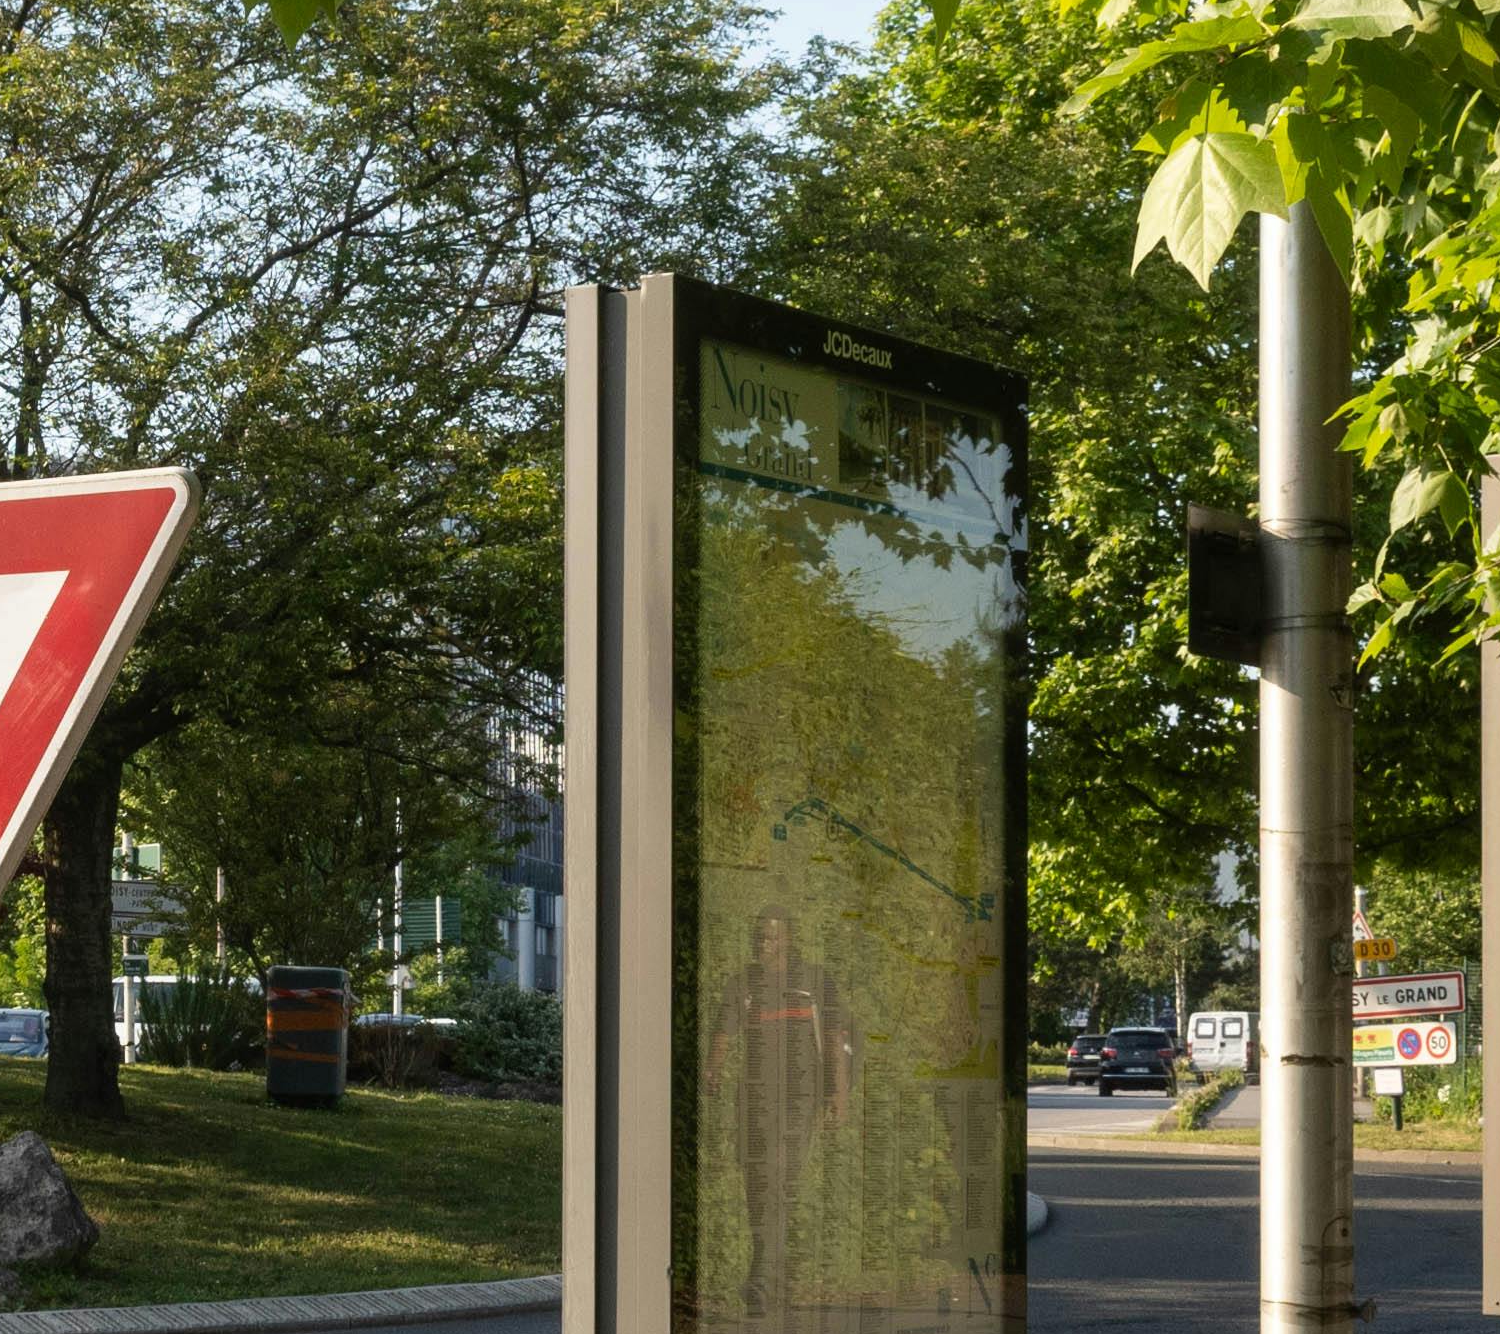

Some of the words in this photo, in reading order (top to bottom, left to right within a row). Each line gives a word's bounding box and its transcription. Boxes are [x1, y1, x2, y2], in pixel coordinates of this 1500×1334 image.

[823, 329, 893, 370] JCDecaux
[1361, 945, 1369, 956] D
[1372, 943, 1391, 956] 30
[1377, 994, 1390, 1005] LE
[1395, 985, 1448, 1005] GRAND
[1430, 1035, 1447, 1050] 50
